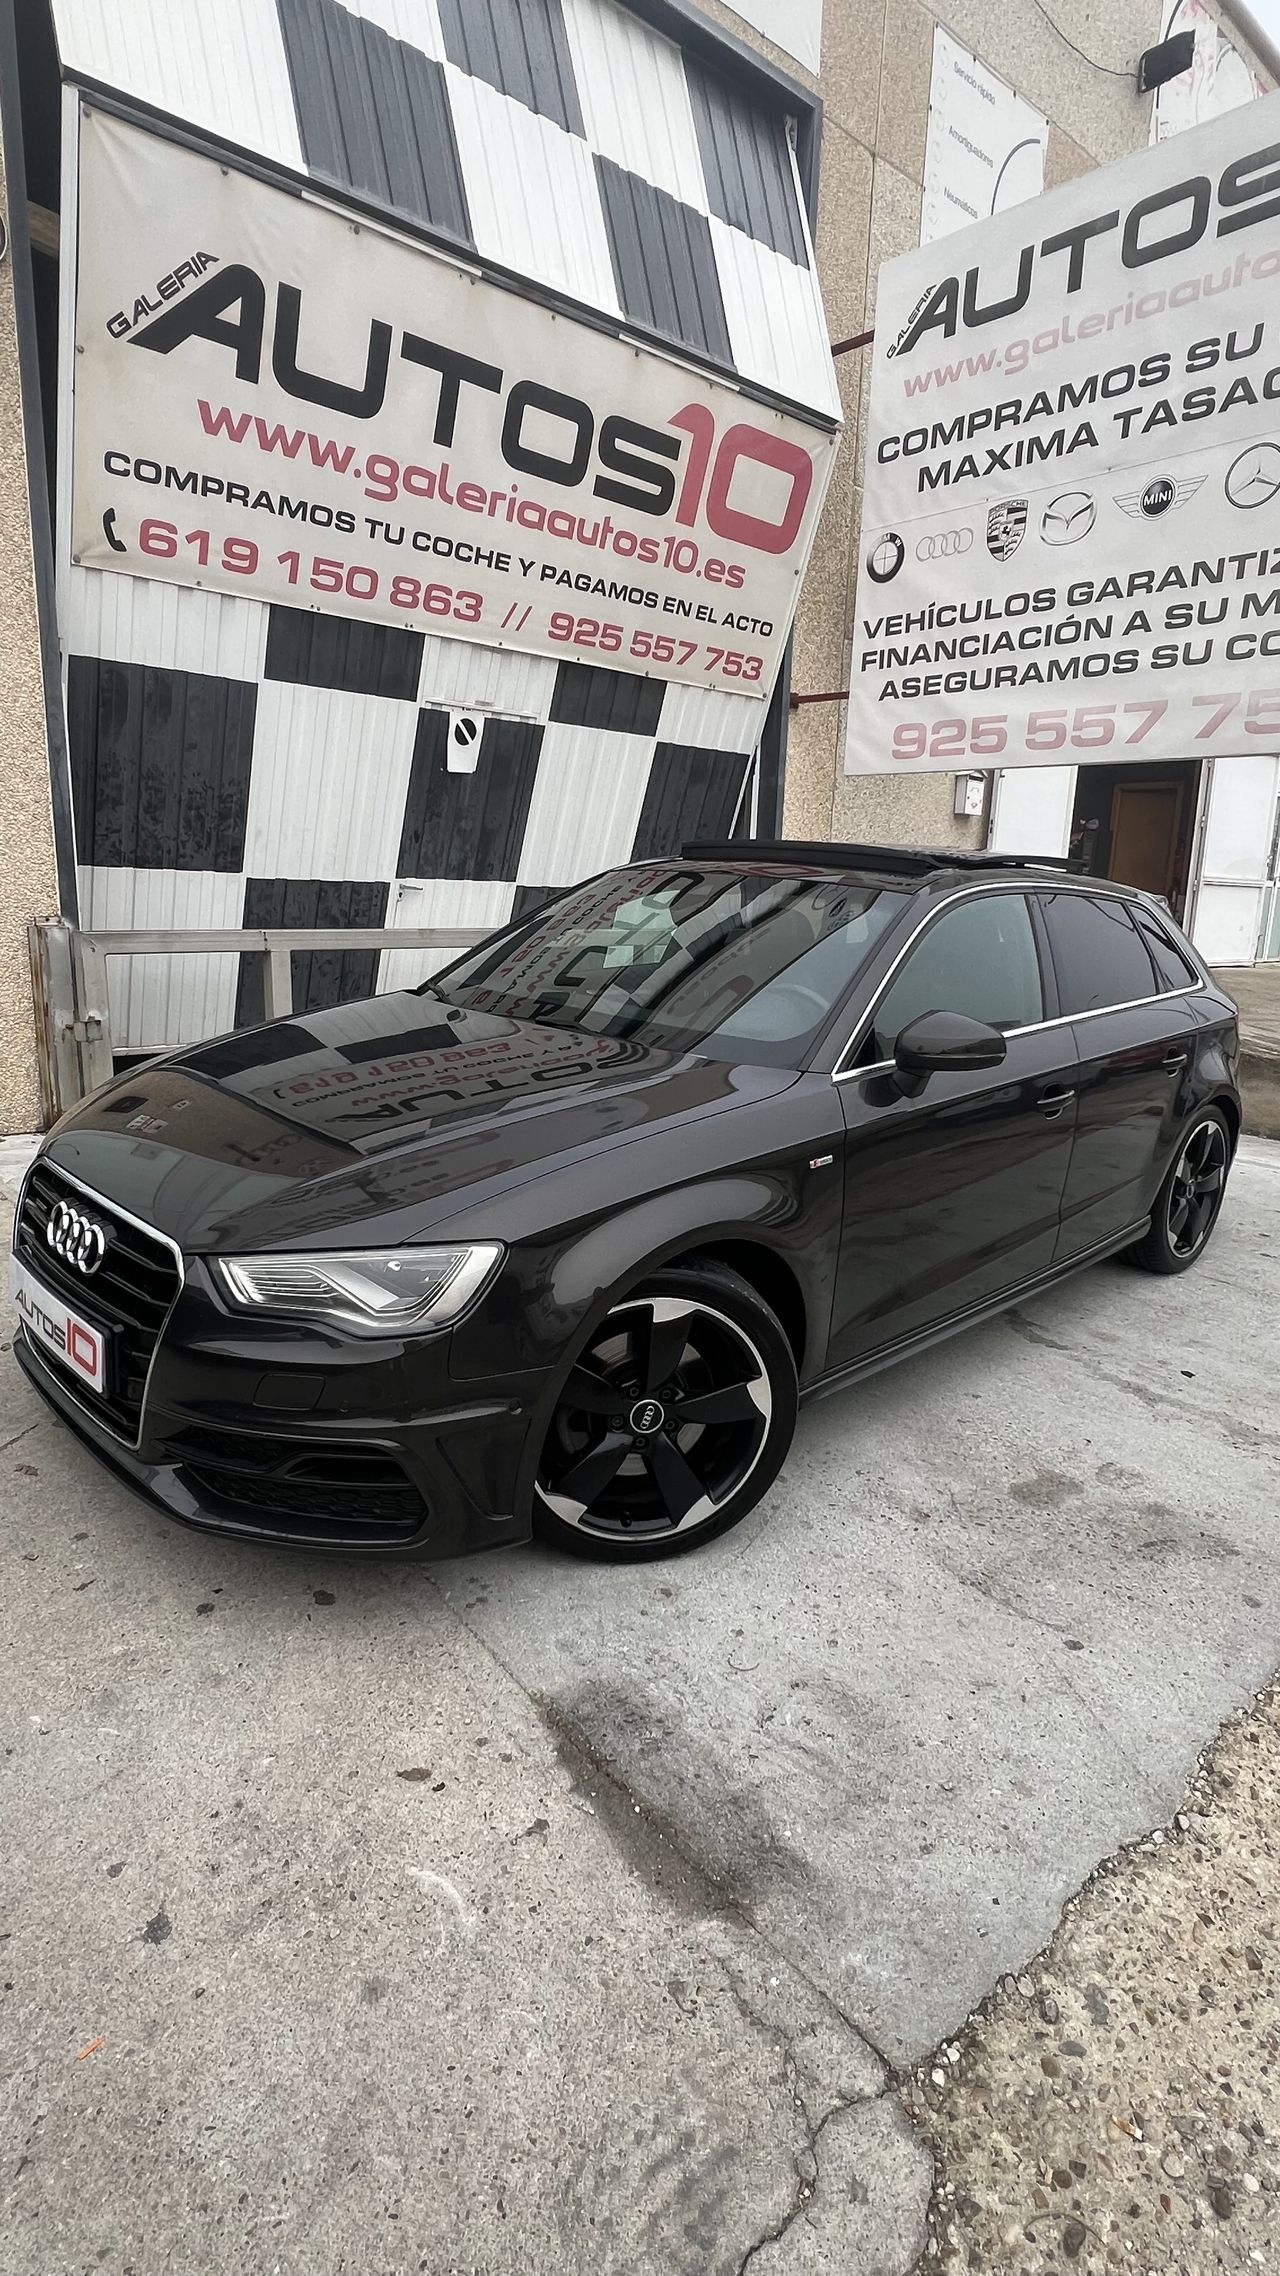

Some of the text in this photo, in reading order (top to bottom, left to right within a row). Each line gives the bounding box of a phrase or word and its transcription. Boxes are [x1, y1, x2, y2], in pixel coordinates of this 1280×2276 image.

[106, 251, 220, 338] GALERIA
[886, 284, 938, 360] GALERIA
[126, 264, 813, 555] AUTOS10
[878, 323, 1264, 463] COMPRAMOS SU
[197, 398, 746, 589] www.galeriaautos10.es
[918, 422, 1099, 492] MAXIMA
[1144, 489, 1172, 506] MINI
[105, 451, 773, 636] COMPRAMOS TU COCHE Y PAGAMOS EN EL ACTO
[138, 518, 259, 576] 619
[277, 550, 379, 600] 150
[389, 576, 484, 623] 863
[547, 612, 624, 652] 925
[630, 632, 698, 666] 557
[703, 646, 764, 682] 753
[862, 614, 1113, 671] FINANCIACIÓN
[1122, 610, 1152, 636] A
[1165, 598, 1228, 629] SU
[864, 588, 1055, 639] VEHÍCULOS
[879, 650, 1139, 701] ASEGURAMOS
[1151, 639, 1213, 669] SU
[890, 688, 1280, 762] 925 557 75
[15, 1288, 97, 1376] AUTOS10
